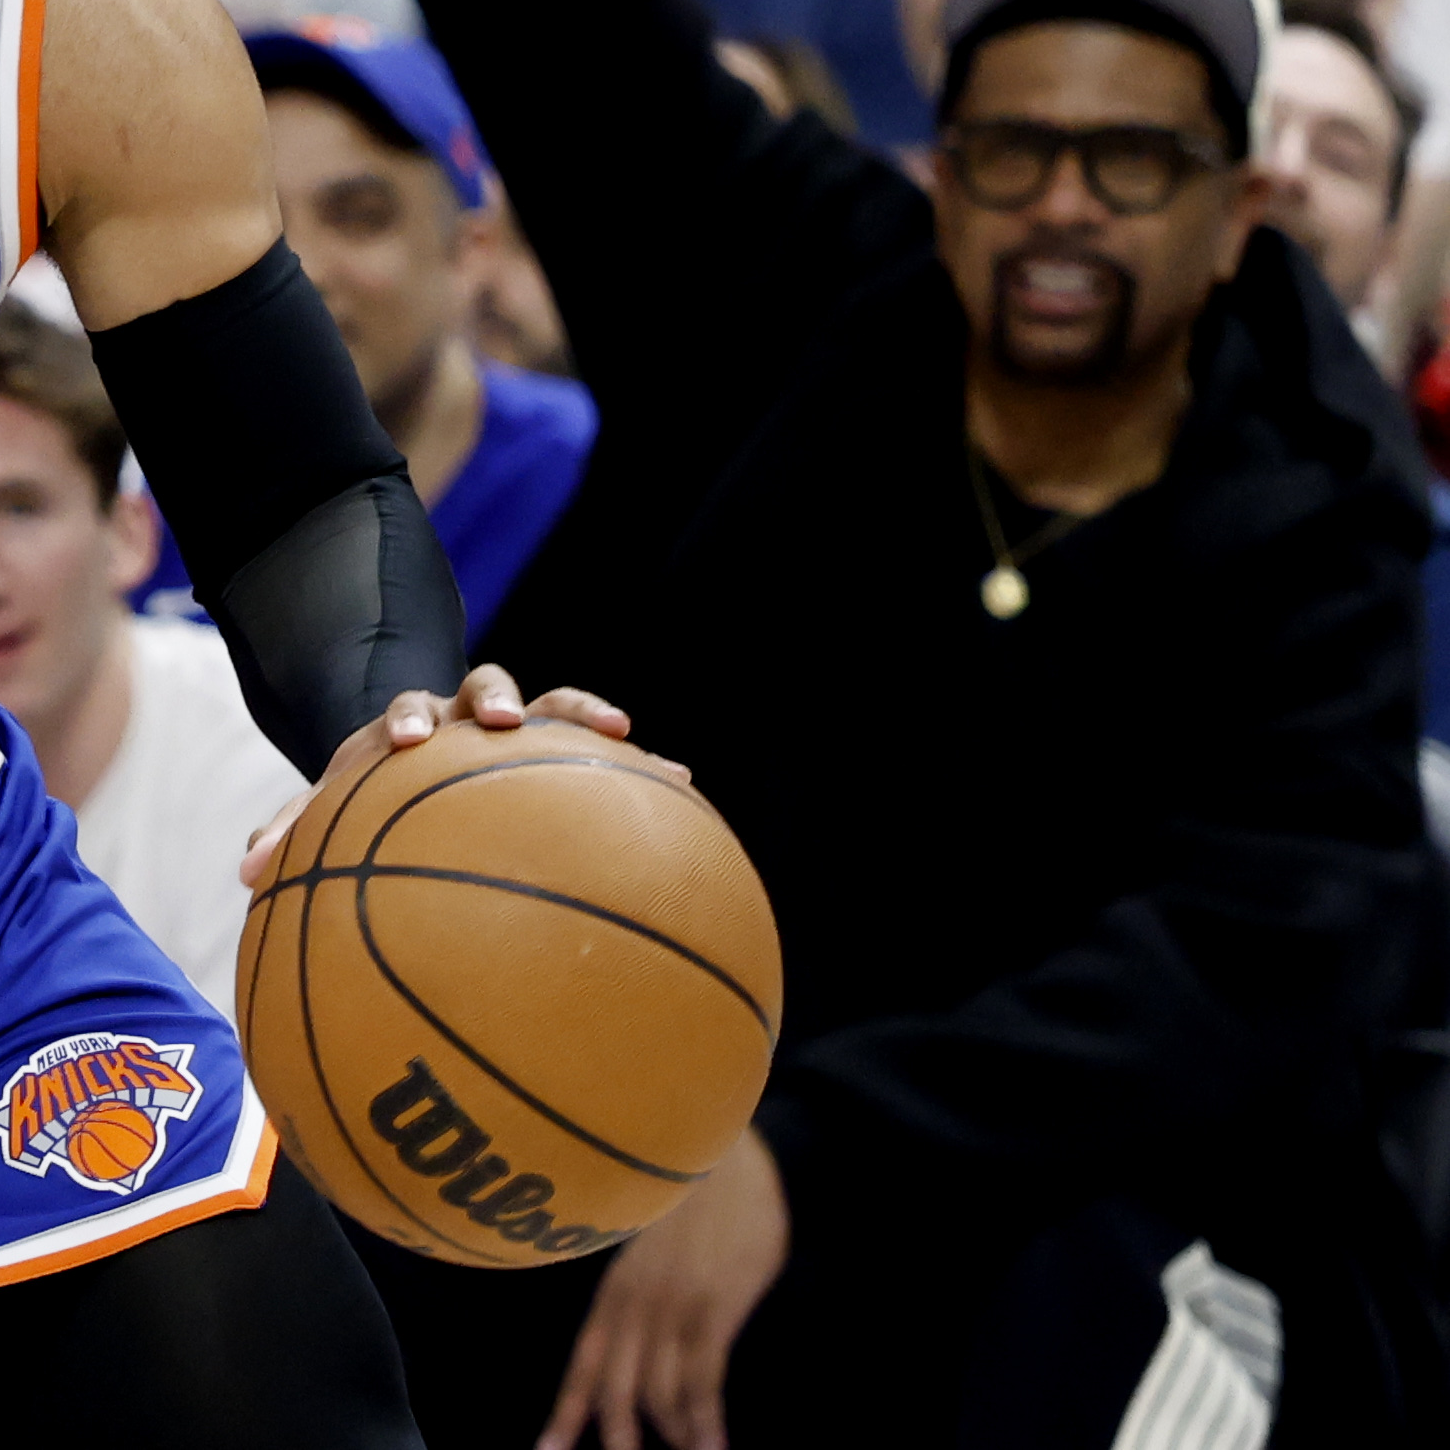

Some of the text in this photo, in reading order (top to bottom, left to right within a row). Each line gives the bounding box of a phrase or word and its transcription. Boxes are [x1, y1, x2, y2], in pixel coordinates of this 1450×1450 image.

[36, 1036, 115, 1073] NEW YORK
[9, 1042, 195, 1161] KNICKS
